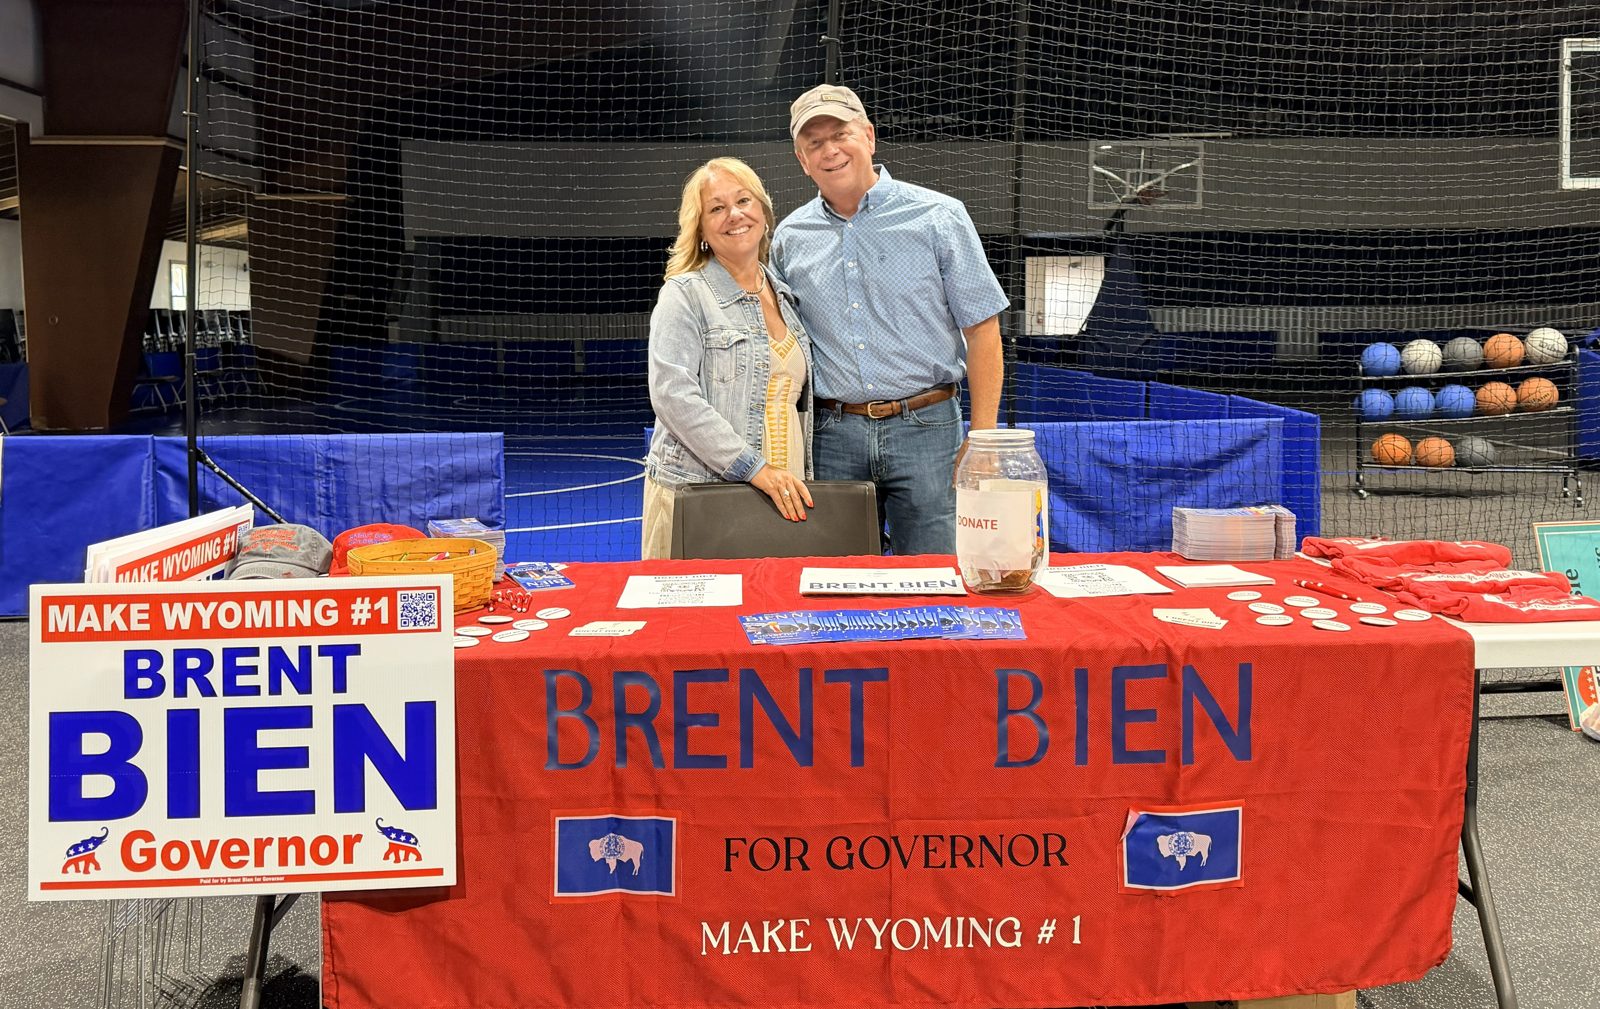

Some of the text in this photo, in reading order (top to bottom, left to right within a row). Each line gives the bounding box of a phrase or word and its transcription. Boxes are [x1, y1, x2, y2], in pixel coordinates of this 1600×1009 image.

[958, 515, 998, 530] DONATE
[118, 559, 159, 583] MAKE
[162, 537, 221, 580] WYOMING
[223, 530, 236, 557] #1
[899, 579, 957, 589] BIEN
[47, 596, 390, 633] MAKE WYOMING #1
[123, 644, 361, 699] BRENT
[542, 662, 1253, 770] BRENT BIEN
[48, 700, 437, 822] BIEN
[120, 828, 363, 872] Governor
[723, 833, 1070, 872] FOR GOVERNOR
[701, 915, 1081, 955] MAKE WYOMING # 1
